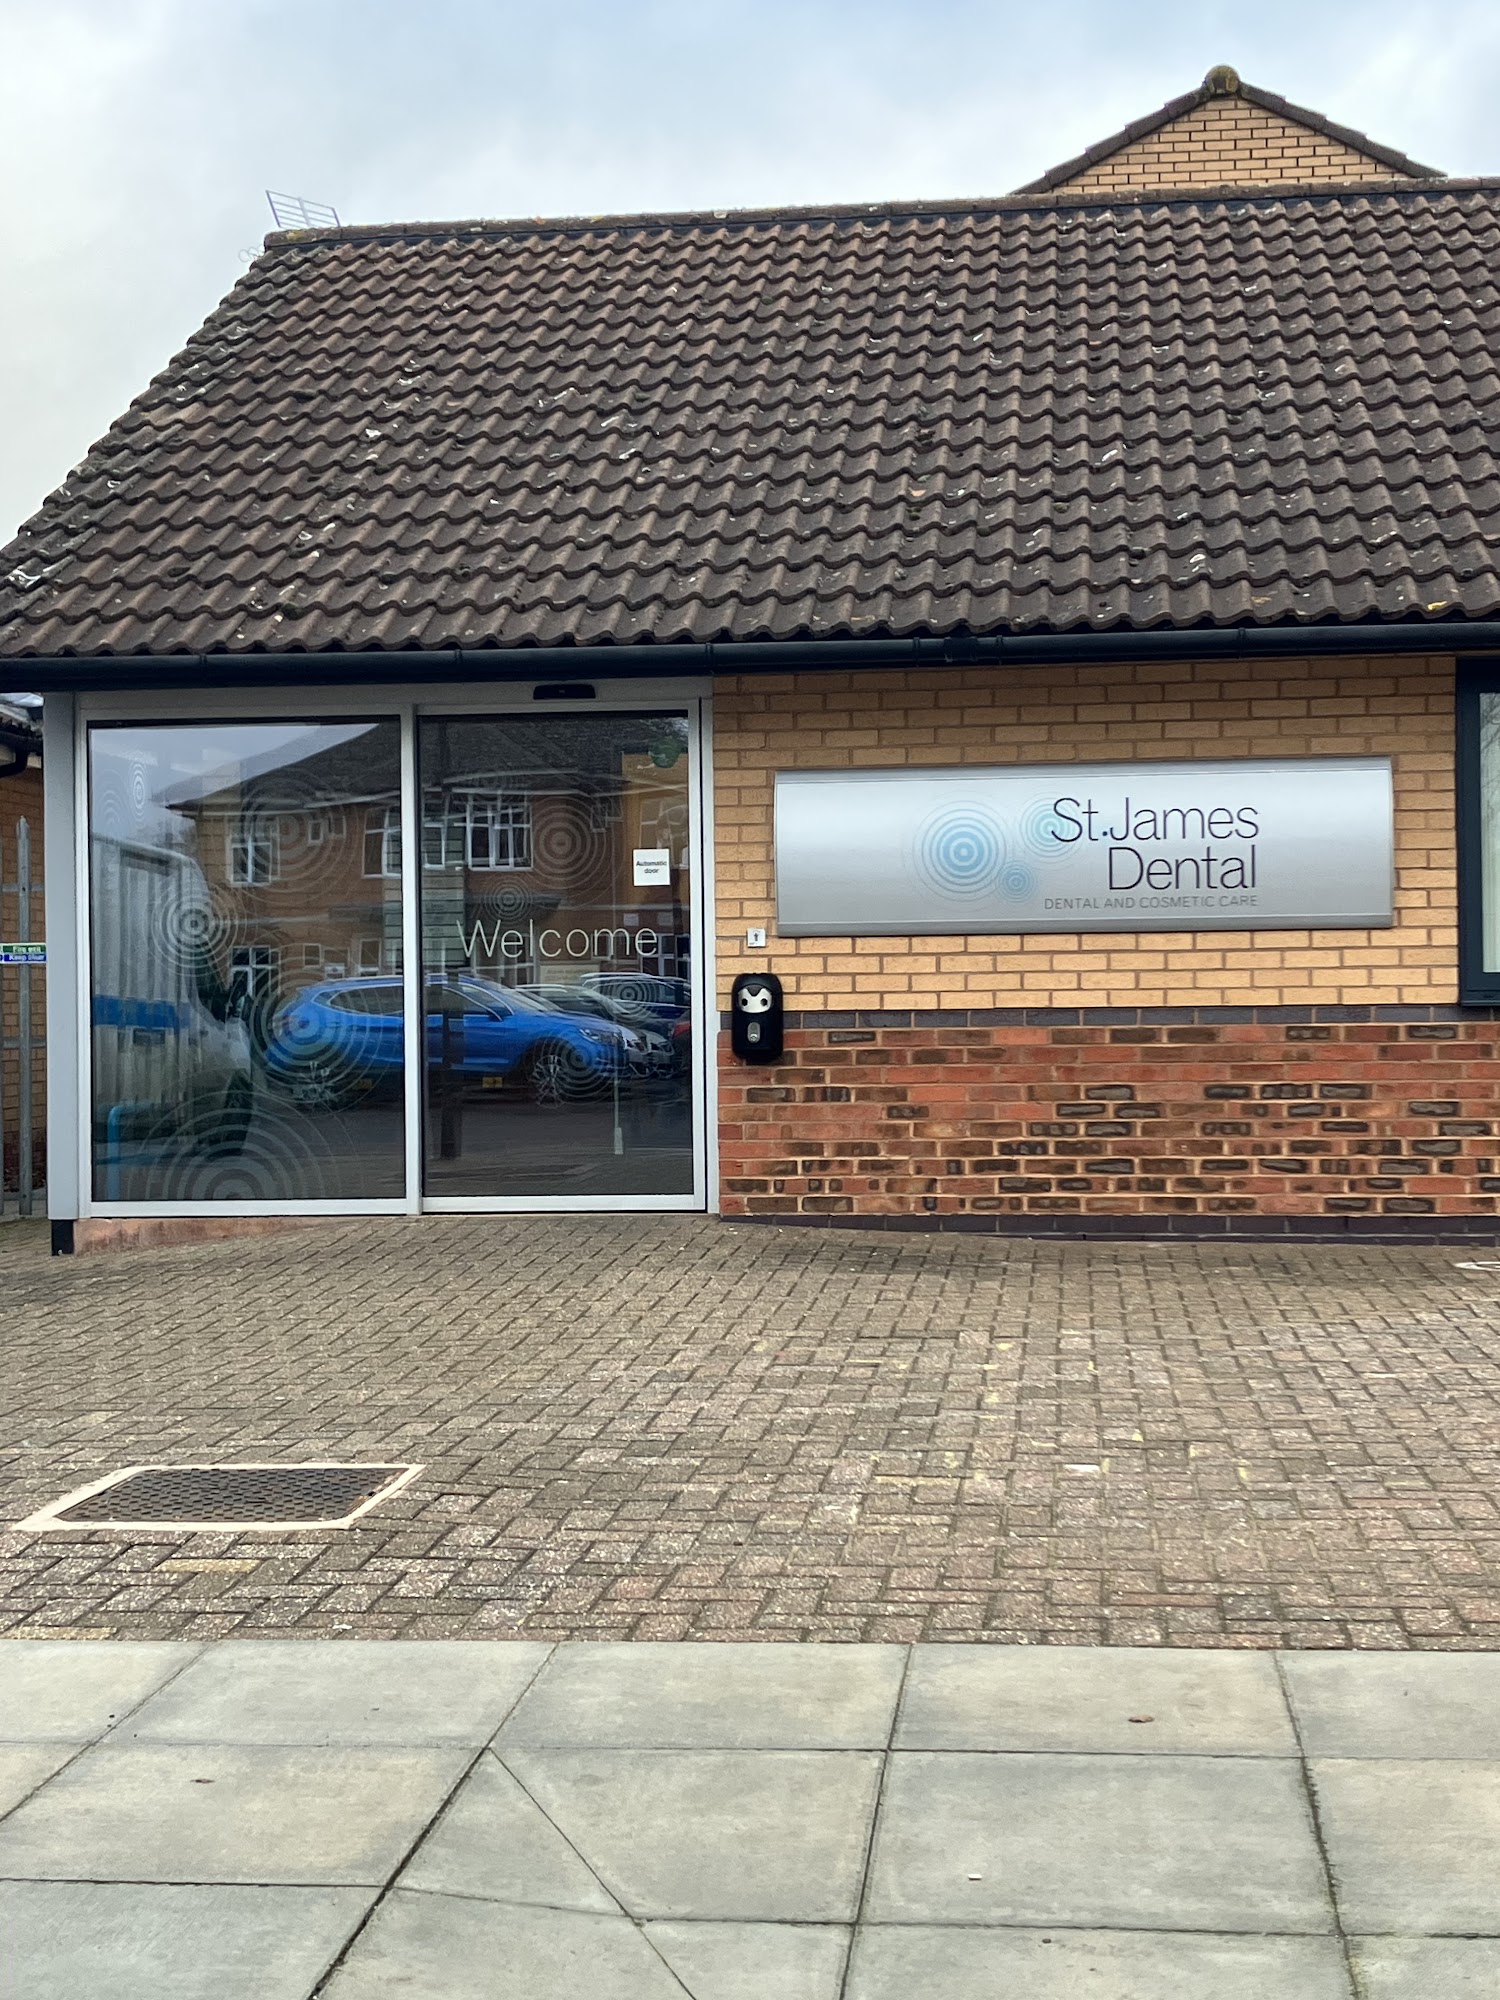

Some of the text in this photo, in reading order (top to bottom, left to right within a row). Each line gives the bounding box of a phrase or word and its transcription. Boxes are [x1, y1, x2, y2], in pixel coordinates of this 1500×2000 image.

[1109, 844, 1256, 890] Dental
[1044, 895, 1259, 910] DENTAL AND COSMETIC CARE
[456, 919, 658, 958] Welcome
